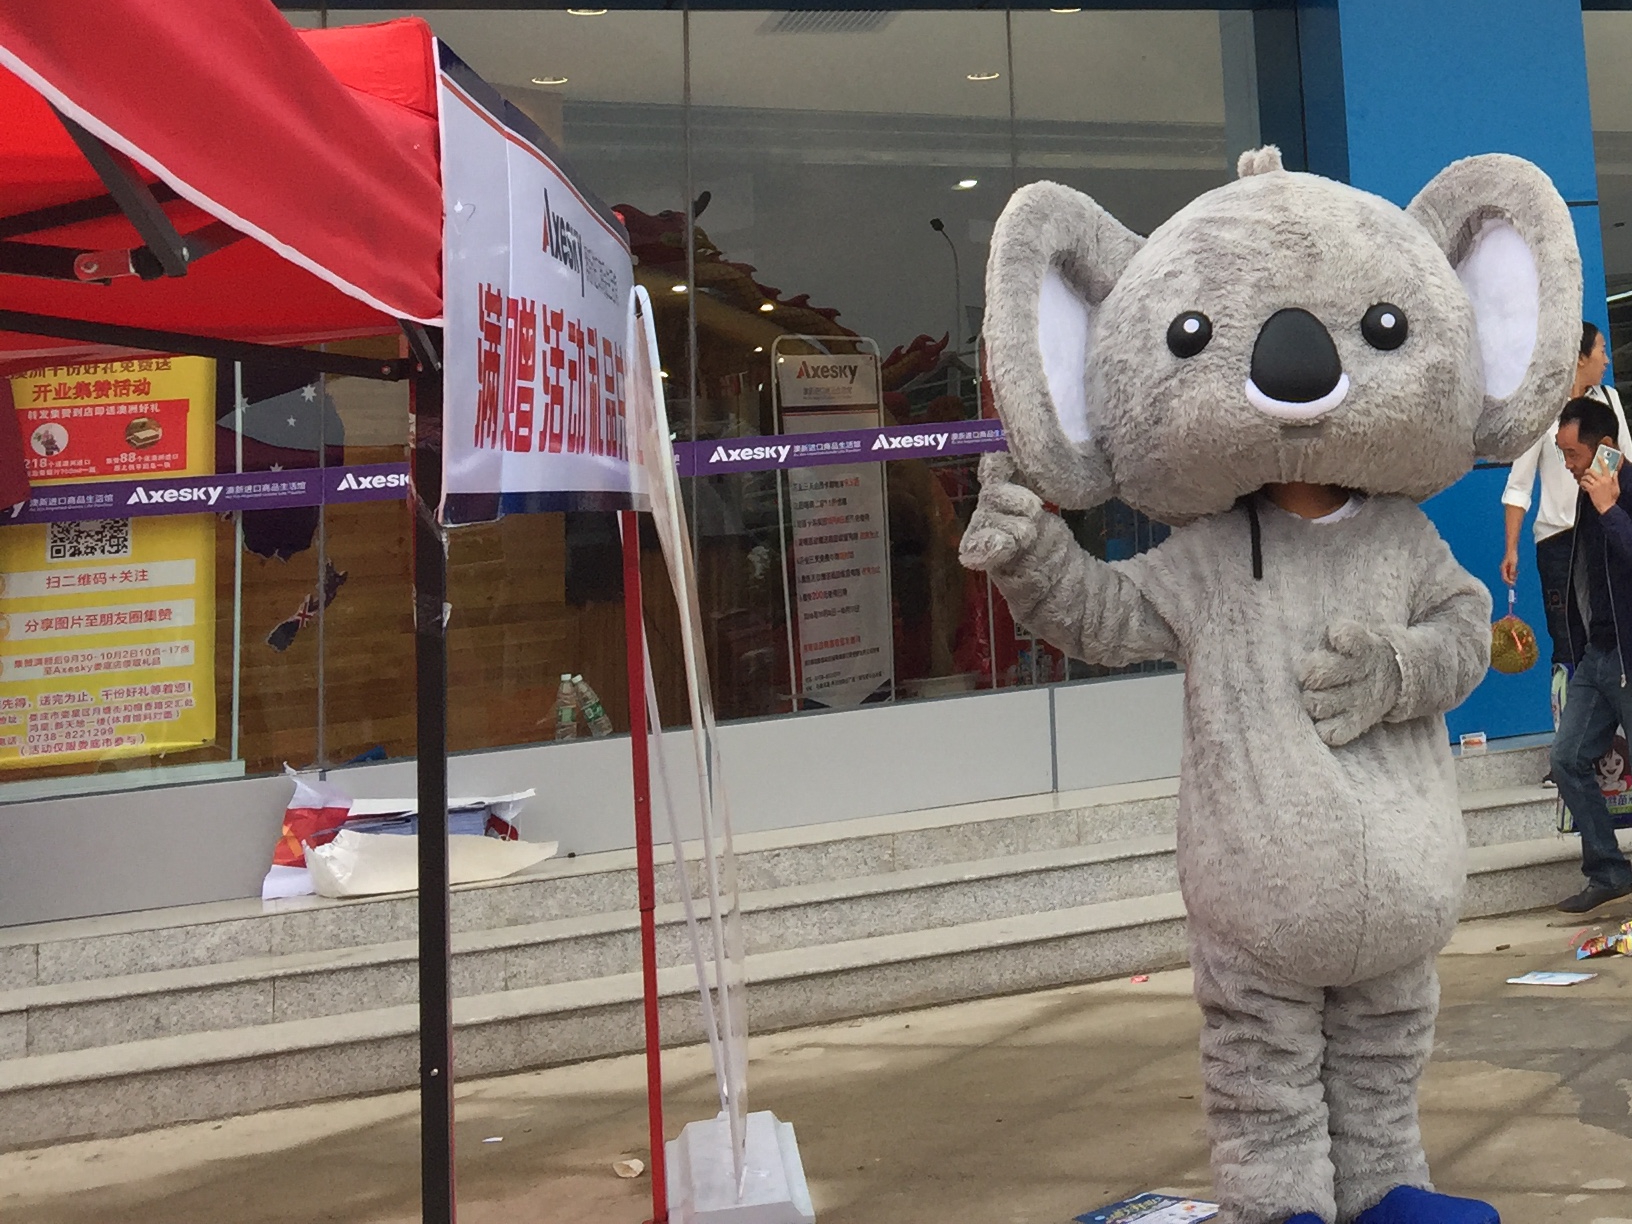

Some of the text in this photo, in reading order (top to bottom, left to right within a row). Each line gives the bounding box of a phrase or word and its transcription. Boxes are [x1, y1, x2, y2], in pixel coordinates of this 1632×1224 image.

[796, 360, 859, 384] Axesky
[871, 432, 949, 451] Axesky
[709, 444, 792, 463] Axesky
[126, 486, 224, 506] Axesky
[46, 568, 149, 590] 扫二维码+关注
[24, 608, 173, 633] 分享图片至朋友圈集赞
